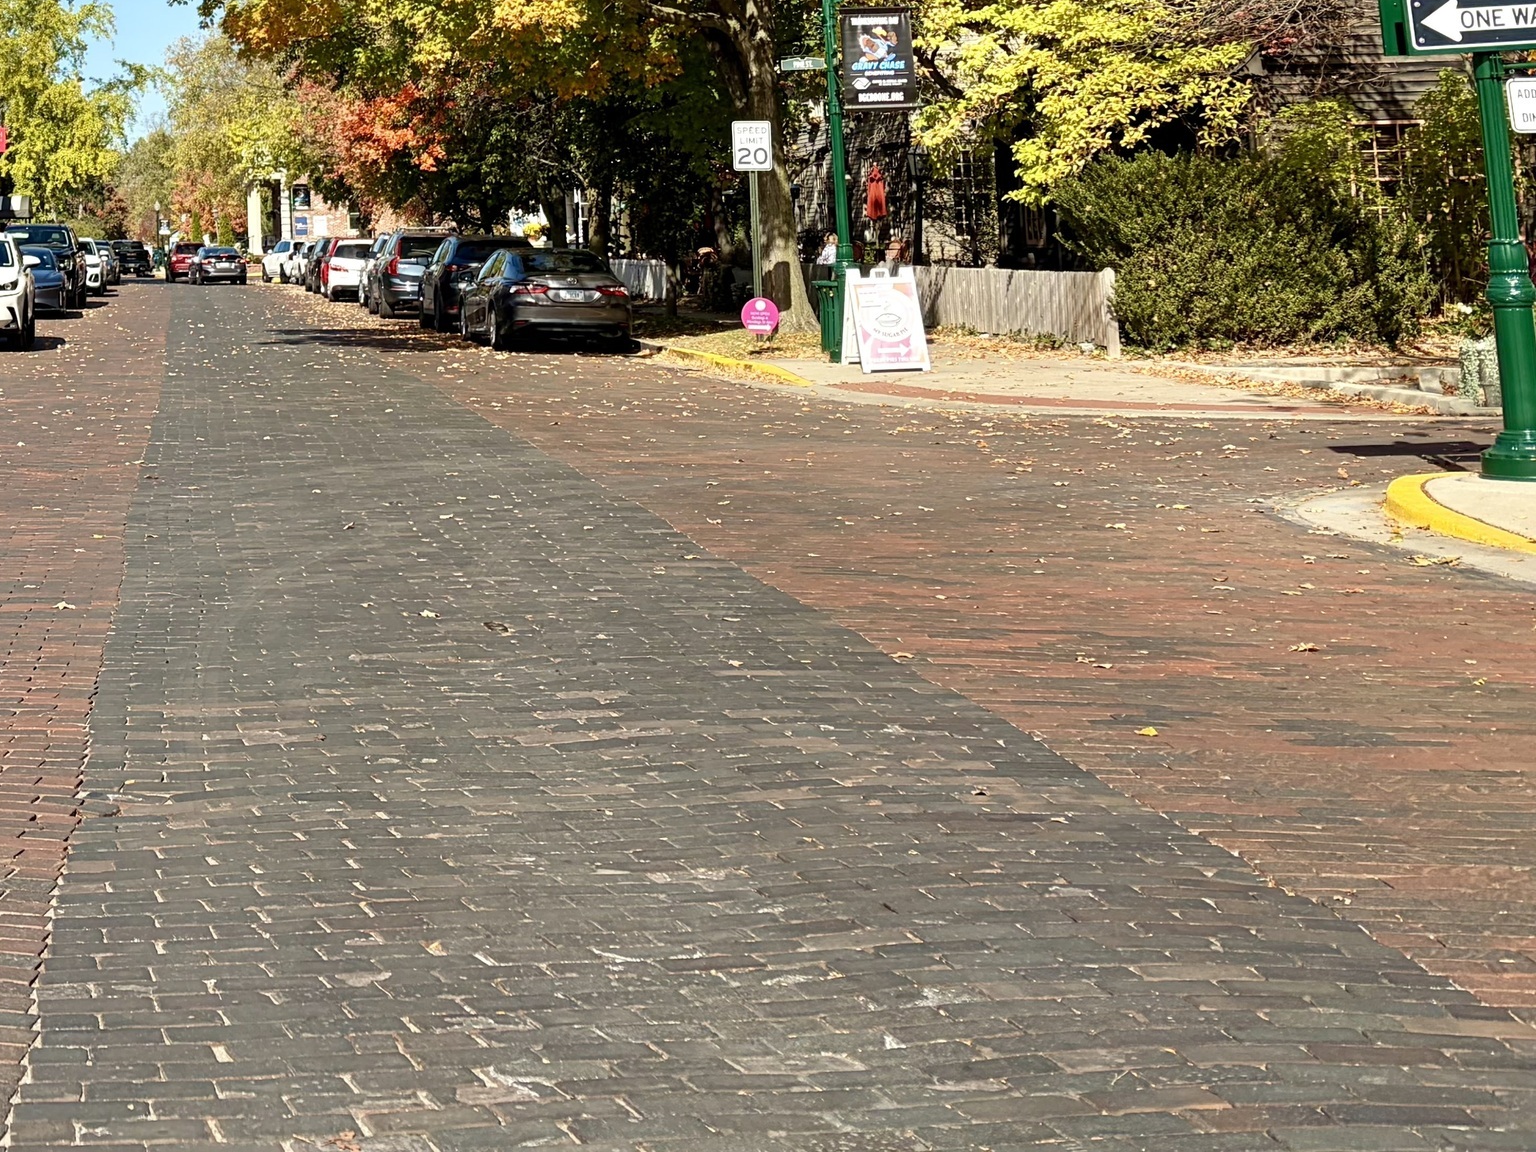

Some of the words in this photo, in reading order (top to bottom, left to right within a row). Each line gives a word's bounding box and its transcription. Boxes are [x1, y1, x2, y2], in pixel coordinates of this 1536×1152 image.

[1461, 9, 1505, 29] ONE
[852, 61, 878, 70] GRAVY
[879, 60, 905, 70] CHASE
[736, 127, 767, 135] SPEED
[739, 137, 763, 145] LIMIT
[737, 147, 768, 165] 20
